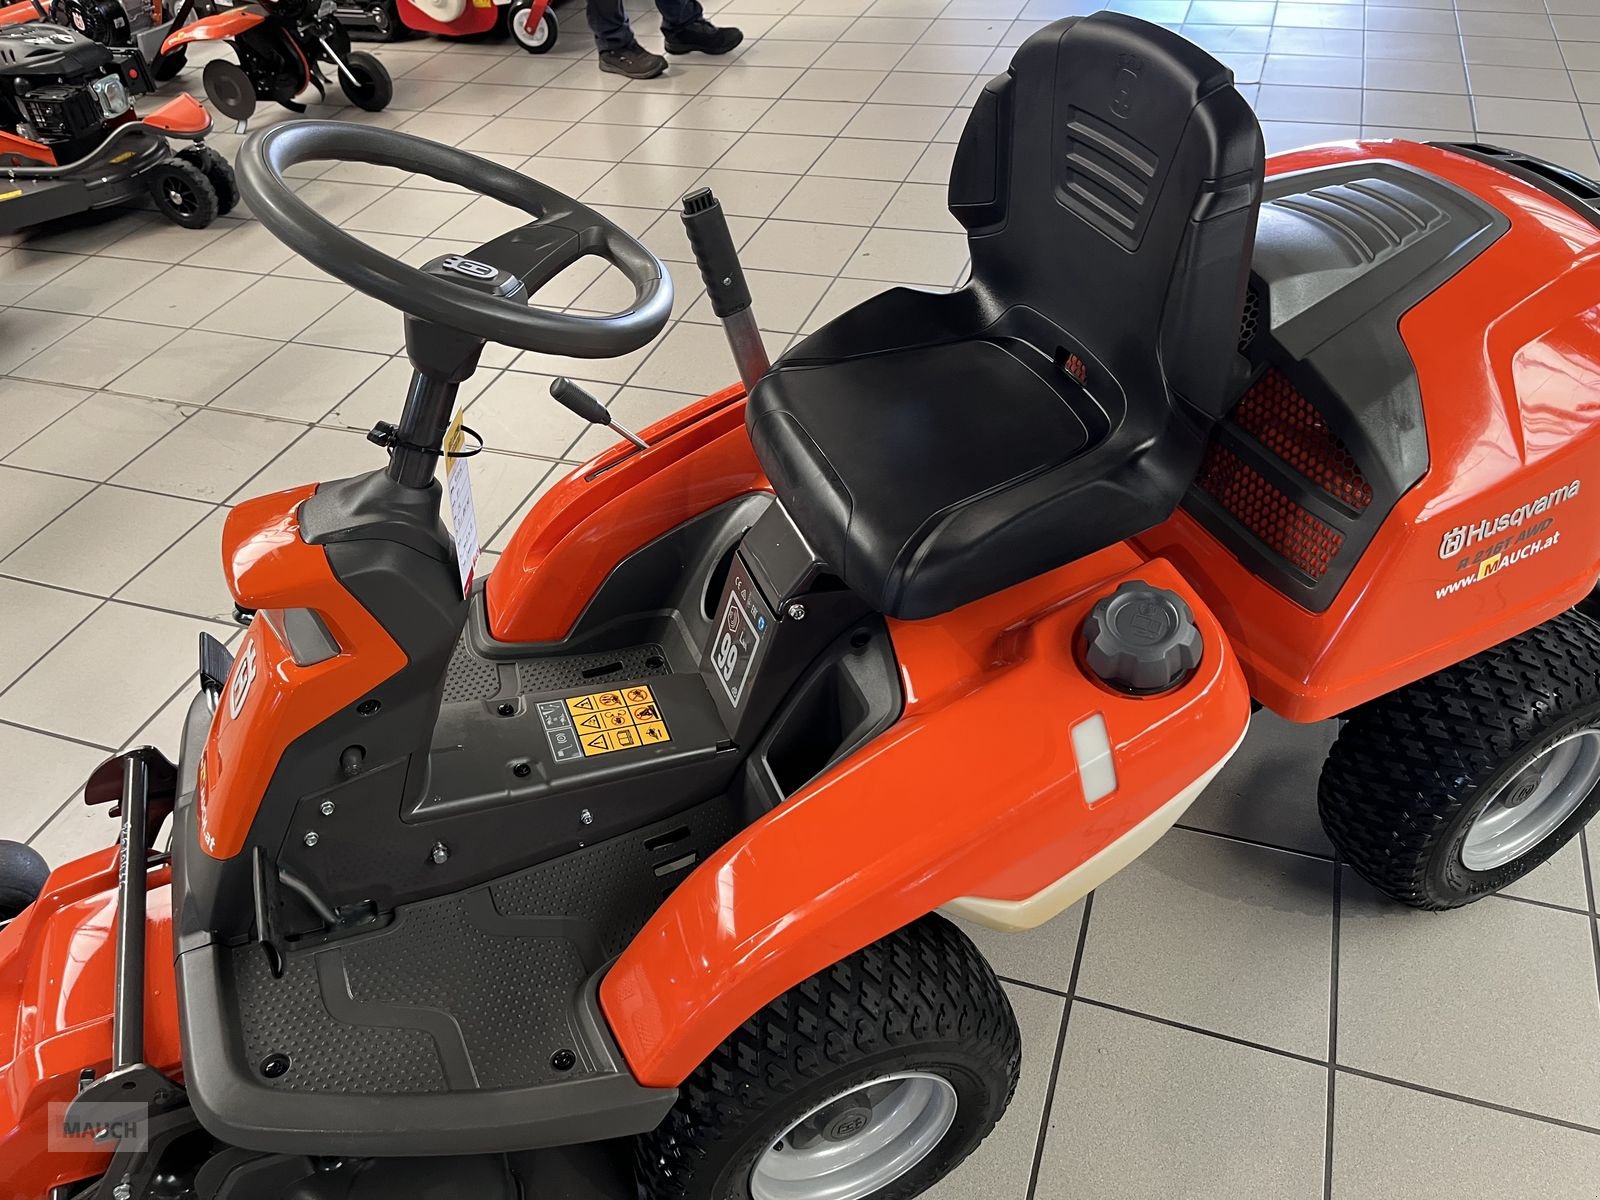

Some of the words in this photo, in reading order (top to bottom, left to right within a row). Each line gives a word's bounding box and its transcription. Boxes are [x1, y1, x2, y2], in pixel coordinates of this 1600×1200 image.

[1466, 479, 1581, 547] Husqvarna
[1515, 518, 1554, 545] AWD
[1435, 530, 1561, 599] www.MAUCH.at
